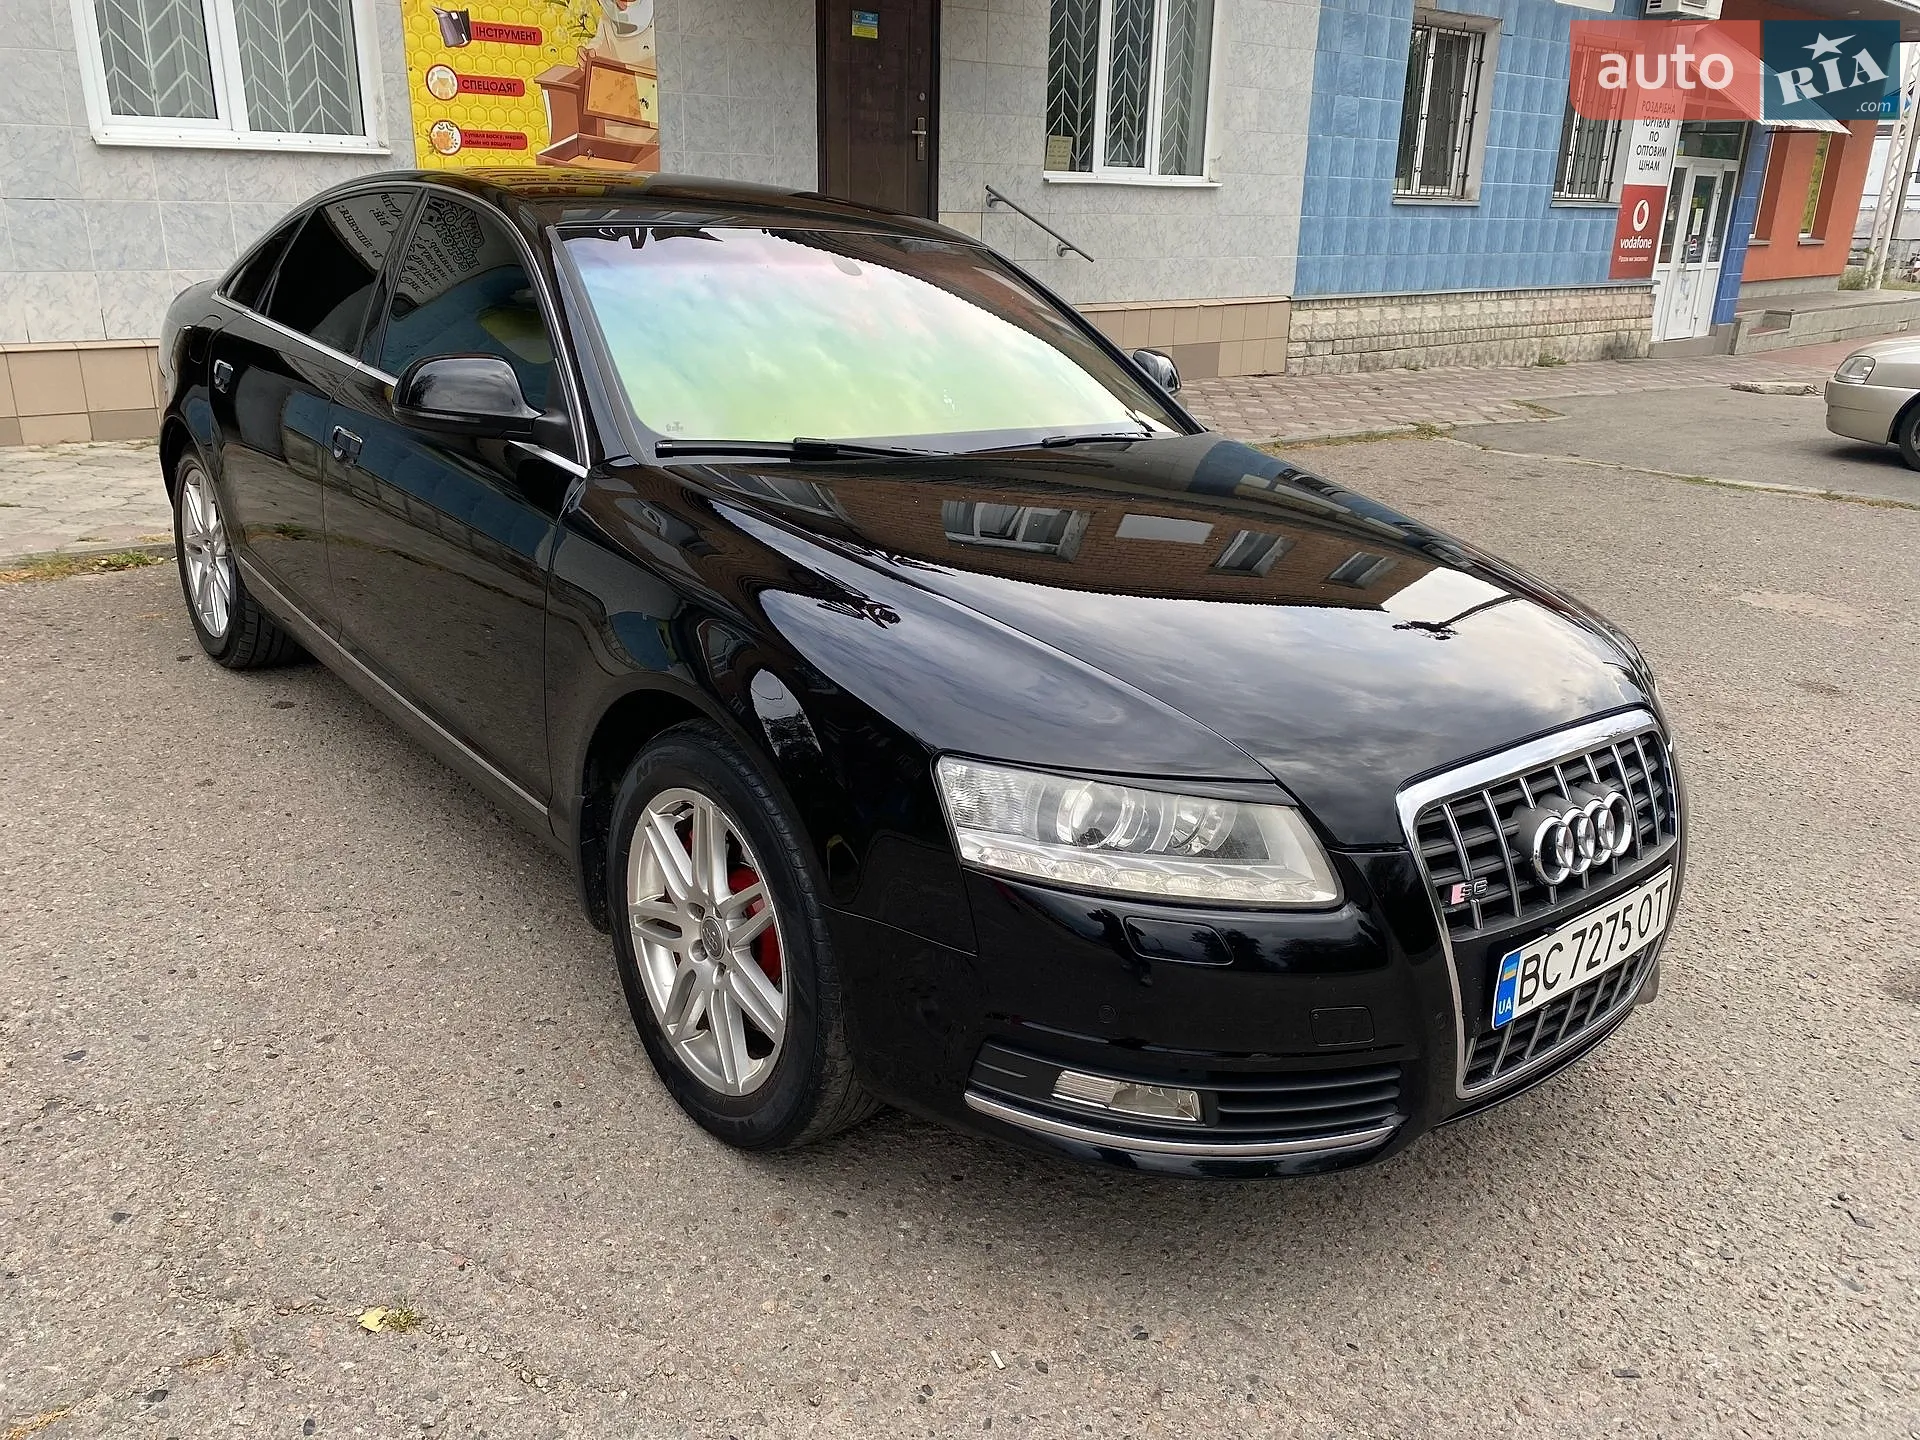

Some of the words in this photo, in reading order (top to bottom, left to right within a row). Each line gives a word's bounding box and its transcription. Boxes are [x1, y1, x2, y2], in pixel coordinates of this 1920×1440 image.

[475, 26, 537, 41] ІНСТРУМЕНТ
[462, 80, 517, 93] СПЕЦОДЯГ
[1641, 100, 1676, 115] РОЗДРІБНА
[1648, 131, 1660, 142] ПО
[1636, 145, 1667, 157] ОПТОВИМ
[1638, 160, 1660, 172] ЦІНАМ
[1620, 236, 1652, 249] vodafone
[1518, 942, 1564, 1008] BC
[1569, 904, 1633, 980] 7275
[1638, 882, 1668, 938] OT
[1498, 997, 1513, 1015] UA
